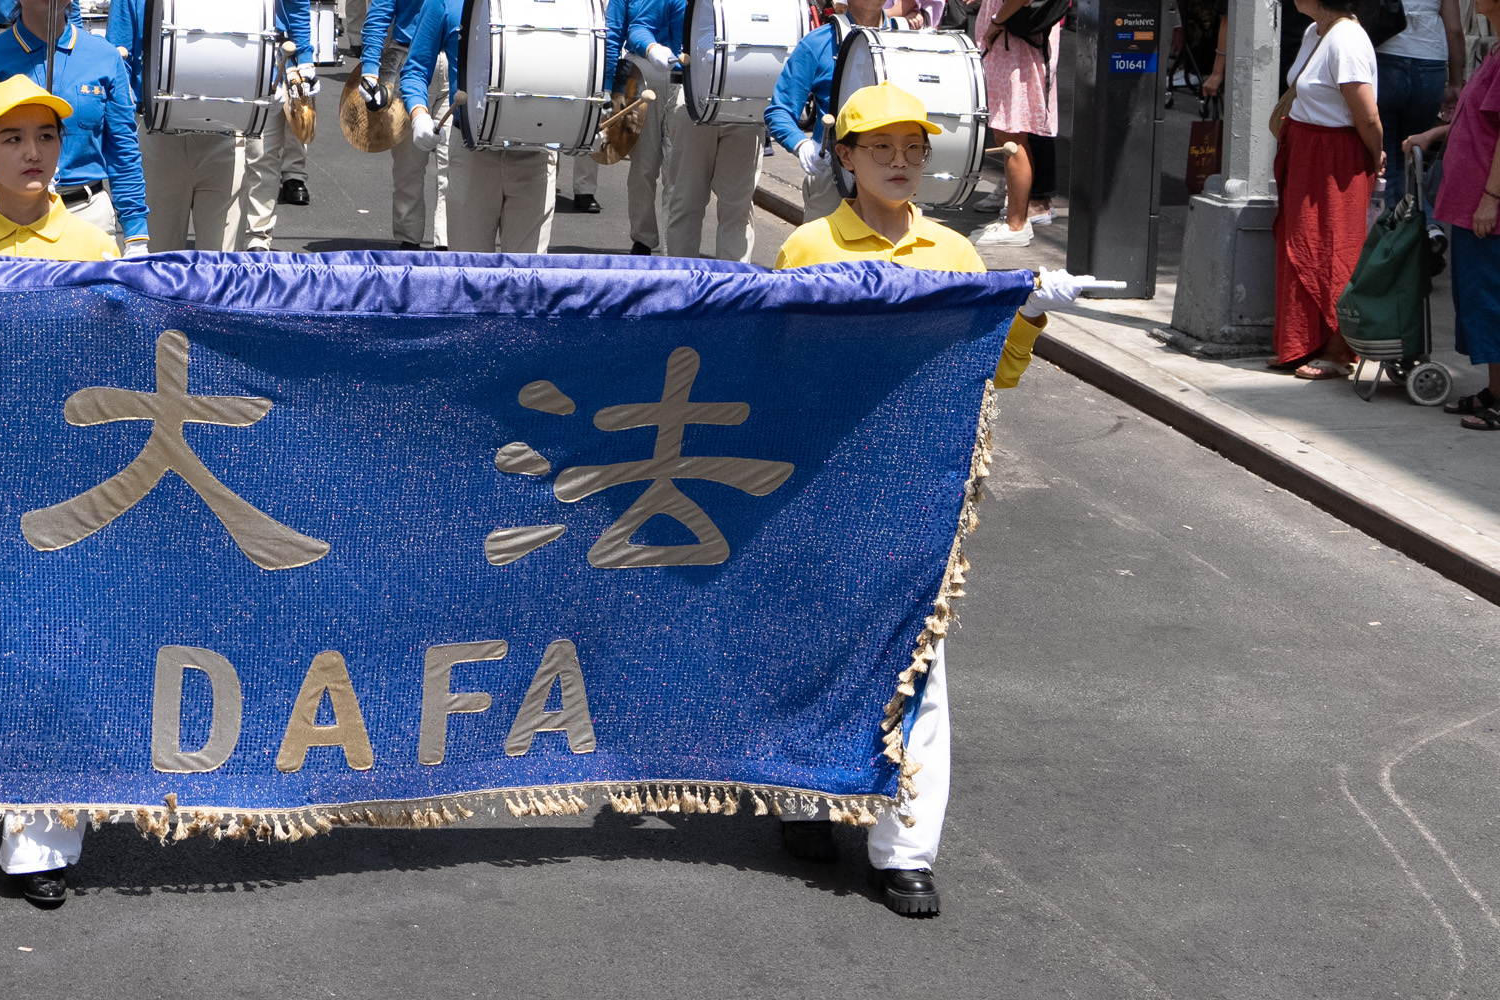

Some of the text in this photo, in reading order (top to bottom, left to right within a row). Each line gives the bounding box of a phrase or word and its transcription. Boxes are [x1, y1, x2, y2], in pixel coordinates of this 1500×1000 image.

[1123, 18, 1155, 26] ParkNYC
[1115, 60, 1146, 70] 101641
[152, 639, 596, 773] DAFA
